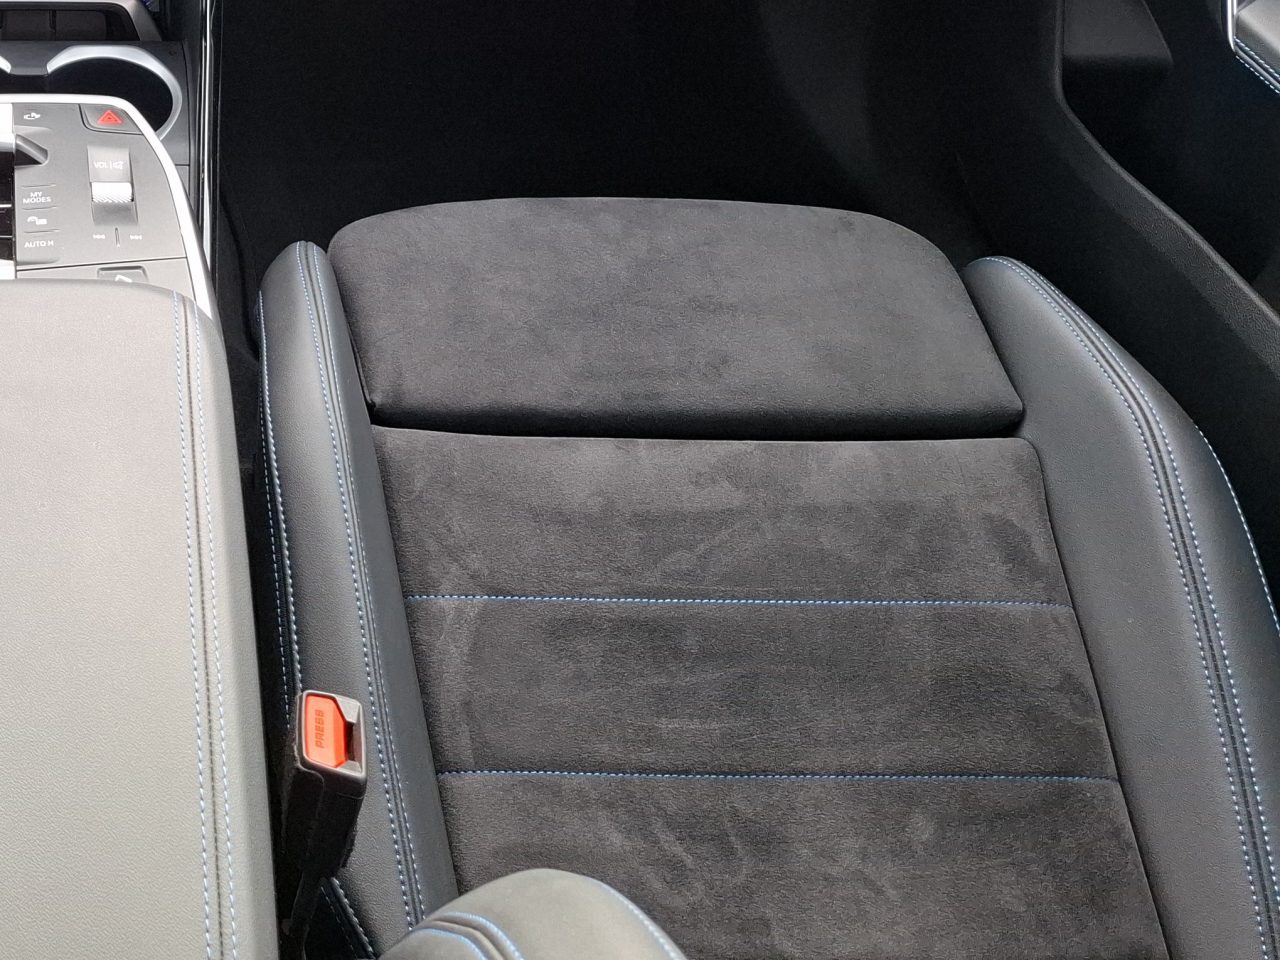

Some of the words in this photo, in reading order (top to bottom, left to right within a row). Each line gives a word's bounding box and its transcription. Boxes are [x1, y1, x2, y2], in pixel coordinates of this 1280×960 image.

[29, 191, 43, 199] MY
[22, 196, 52, 205] MODES
[23, 241, 46, 249] AUTO
[314, 709, 325, 749] PRESS
